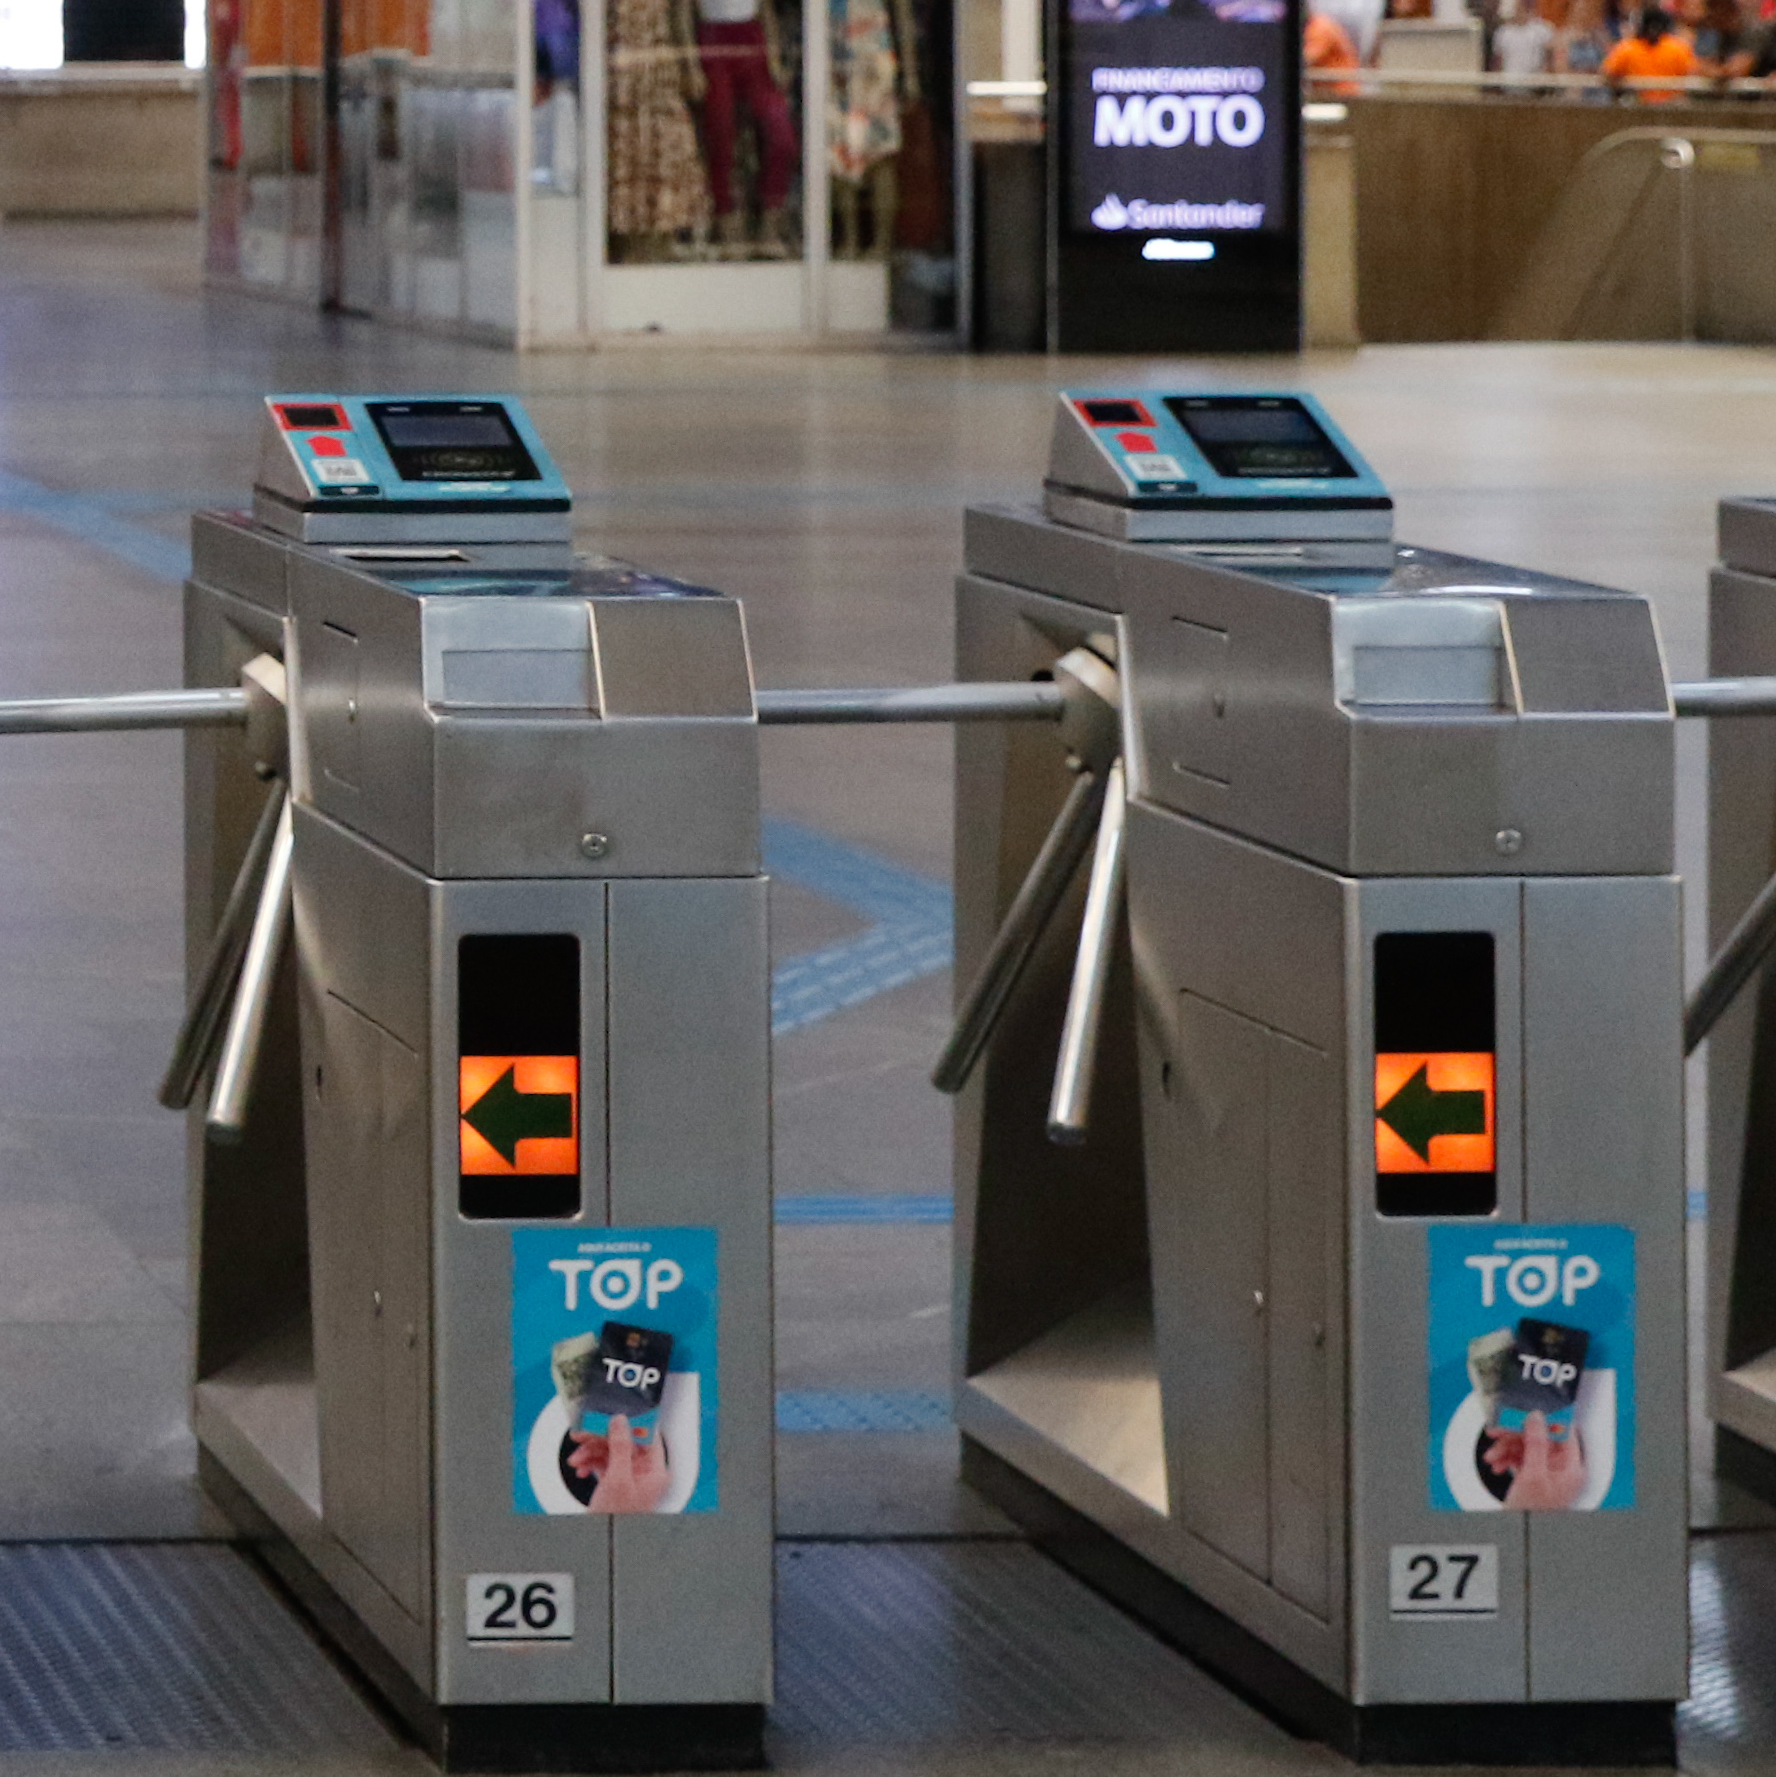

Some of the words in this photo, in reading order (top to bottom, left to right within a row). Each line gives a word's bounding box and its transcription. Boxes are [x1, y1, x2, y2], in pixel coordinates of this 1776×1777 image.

[1094, 94, 1266, 148] MOTO
[1127, 198, 1266, 230] Santander
[548, 1258, 684, 1311] TOP
[1465, 1254, 1601, 1307] TOP
[602, 1357, 660, 1390] TOP
[1519, 1354, 1577, 1388] TOP
[1407, 1554, 1479, 1600] 27
[483, 1582, 557, 1629] 26
